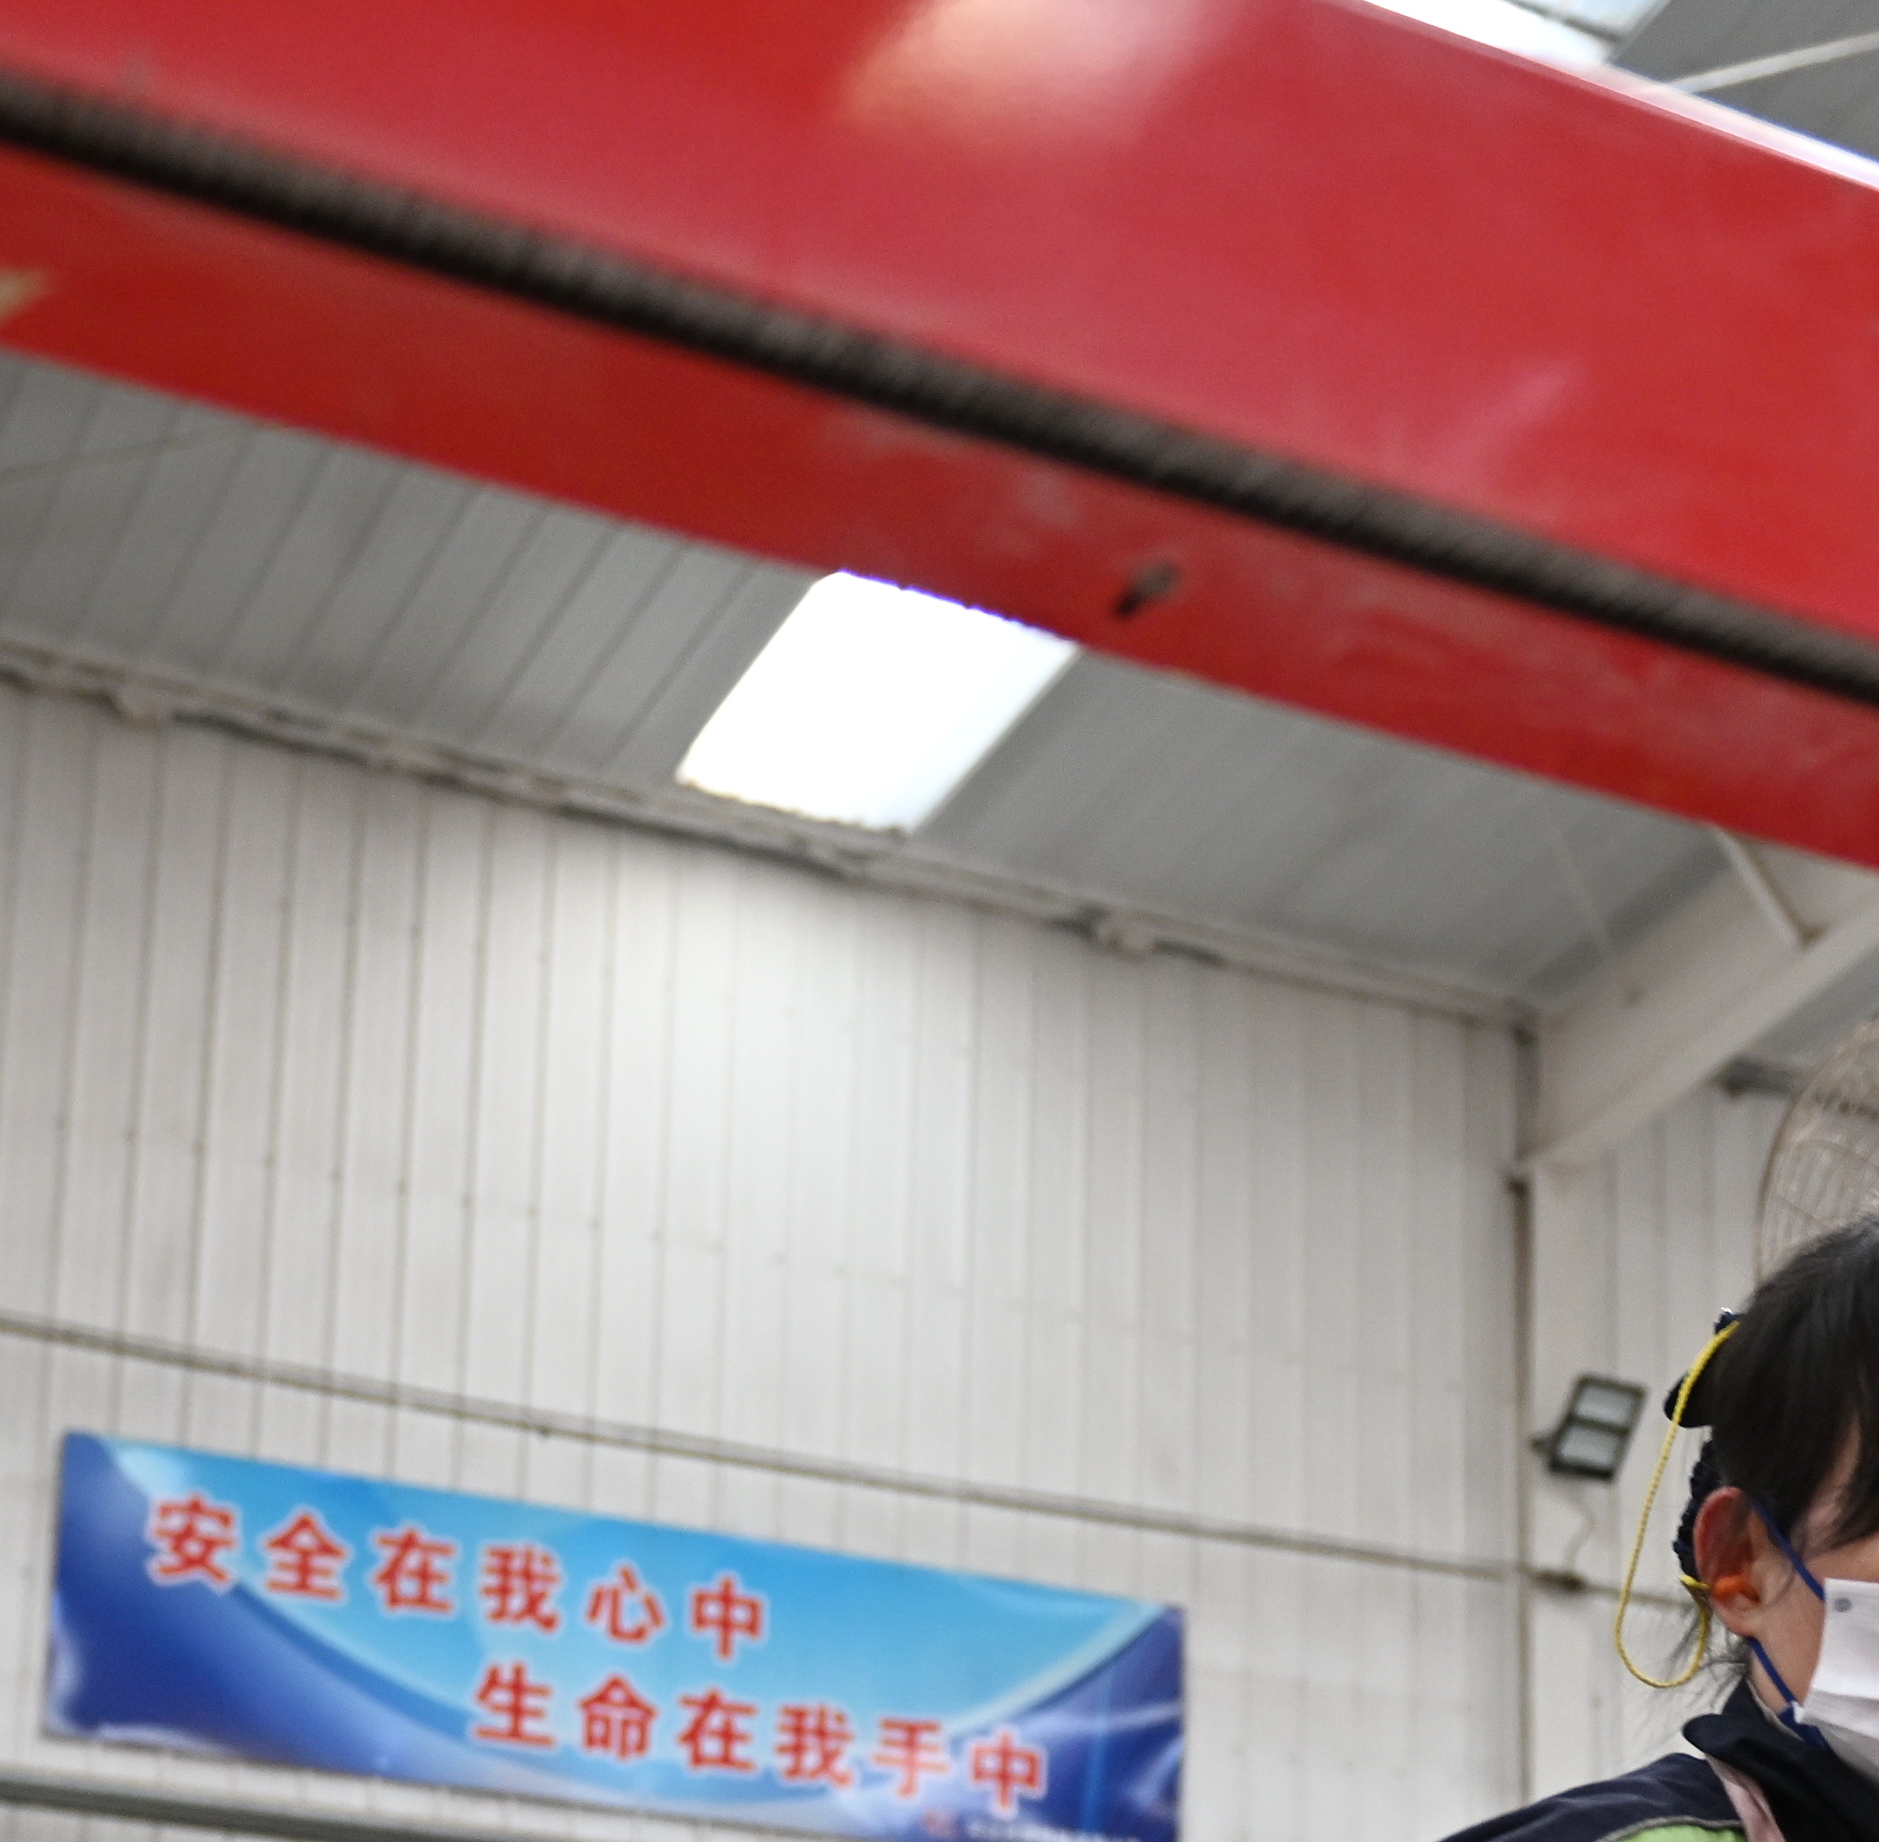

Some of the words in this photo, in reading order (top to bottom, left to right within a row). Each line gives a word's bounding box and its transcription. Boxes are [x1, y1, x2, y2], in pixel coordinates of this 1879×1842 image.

[150, 1494, 767, 1660] 安全在我心中
[470, 1663, 1046, 1813] 生命在我手中
